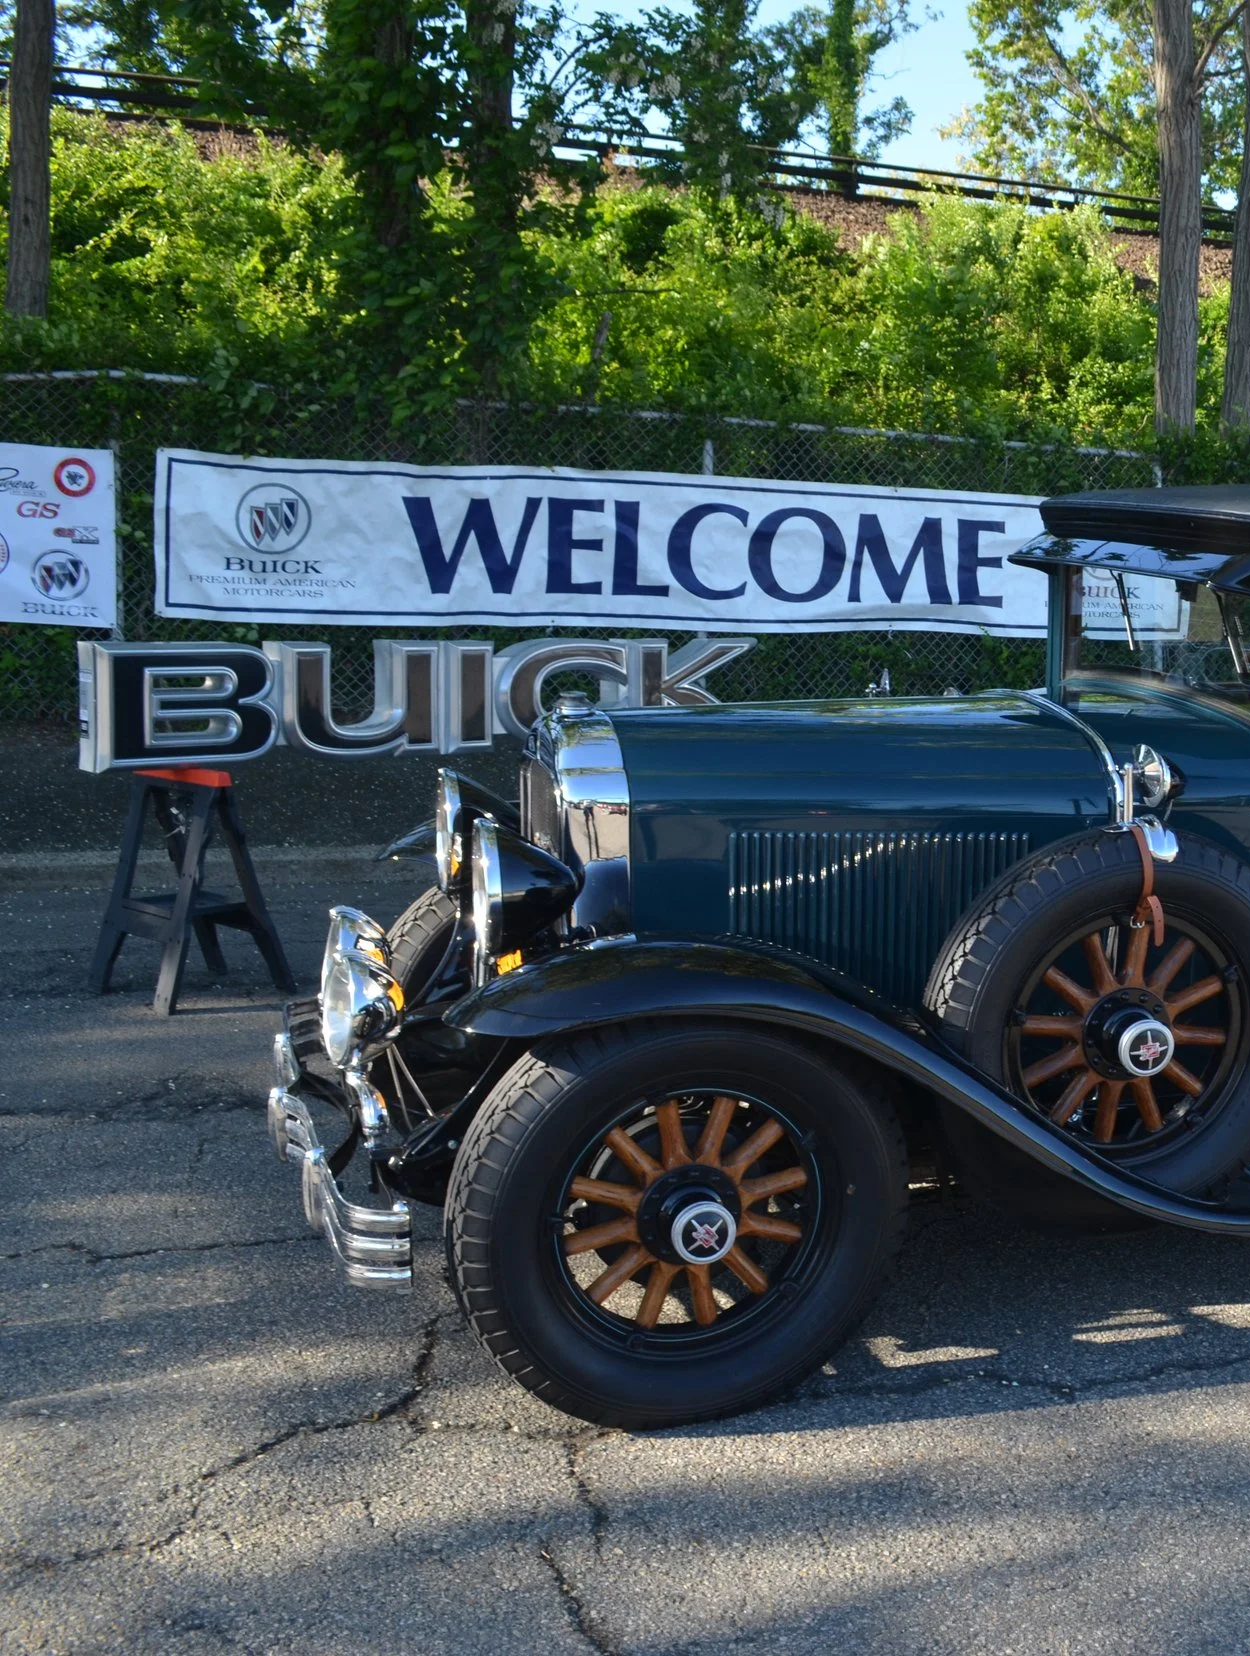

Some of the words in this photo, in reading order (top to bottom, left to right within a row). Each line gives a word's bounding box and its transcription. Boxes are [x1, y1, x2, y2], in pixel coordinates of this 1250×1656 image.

[17, 500, 61, 519] GS
[403, 496, 1006, 609] WELCOME
[224, 556, 323, 575] BUICK
[188, 574, 267, 586] PREMIUM
[273, 578, 356, 589] AMERICAN
[222, 586, 324, 598] MOTORCARS
[21, 602, 98, 617] BUICK
[77, 638, 758, 773] BUICK
